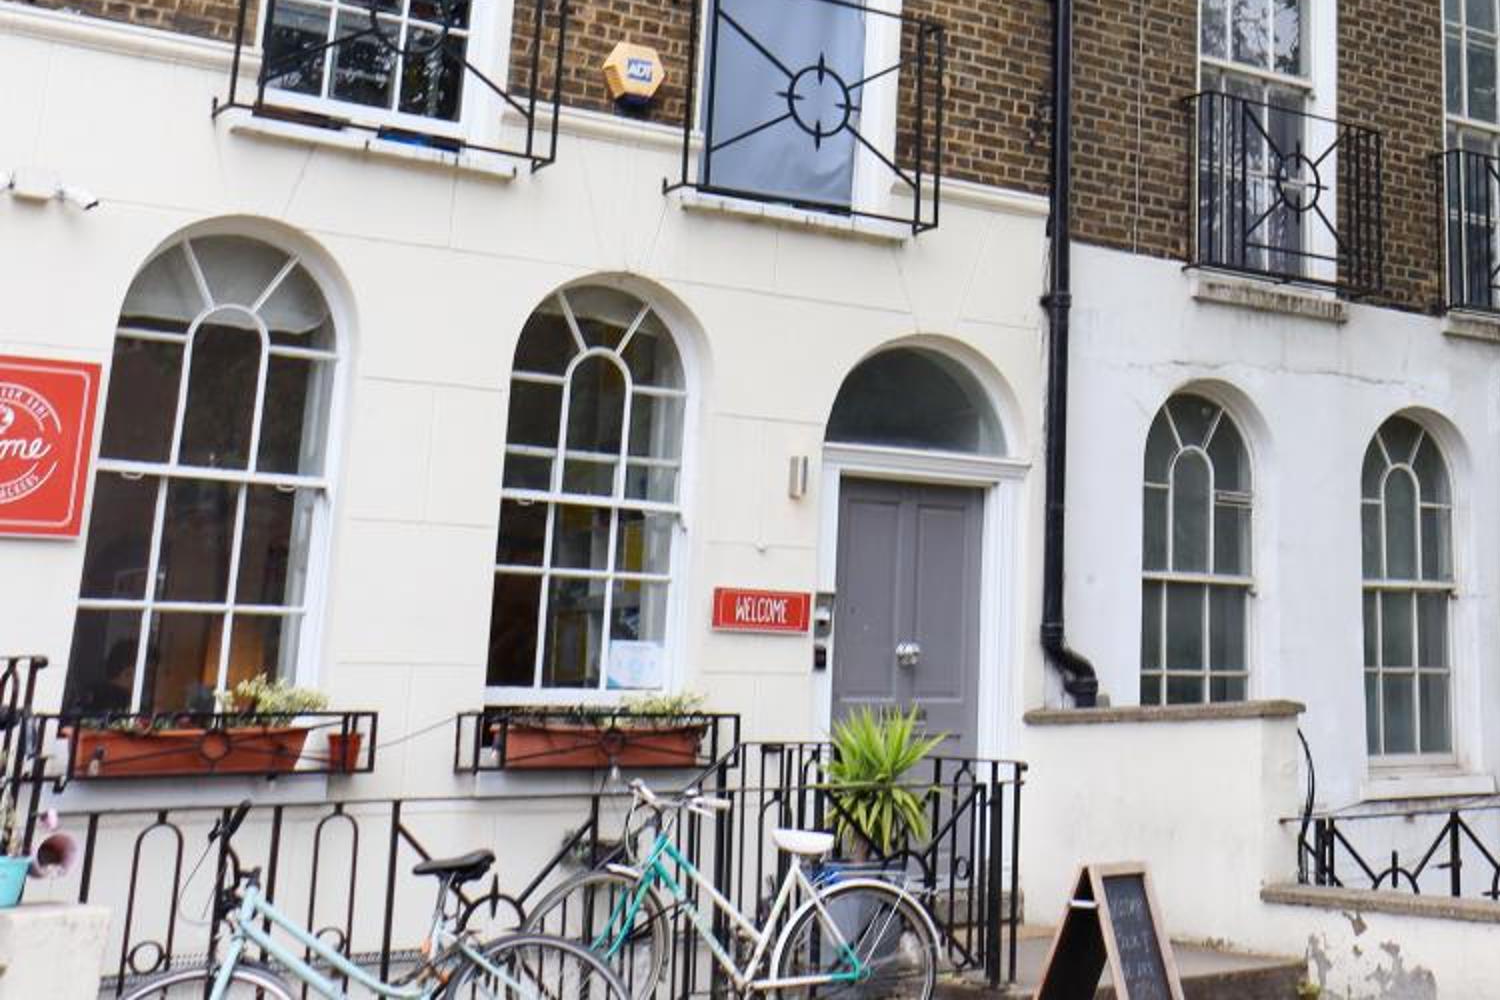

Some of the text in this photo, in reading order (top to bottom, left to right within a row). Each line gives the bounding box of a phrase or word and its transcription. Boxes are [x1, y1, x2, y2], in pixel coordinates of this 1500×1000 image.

[628, 62, 653, 81] ADT
[0, 437, 52, 461] me
[735, 596, 788, 625] WELCOME
